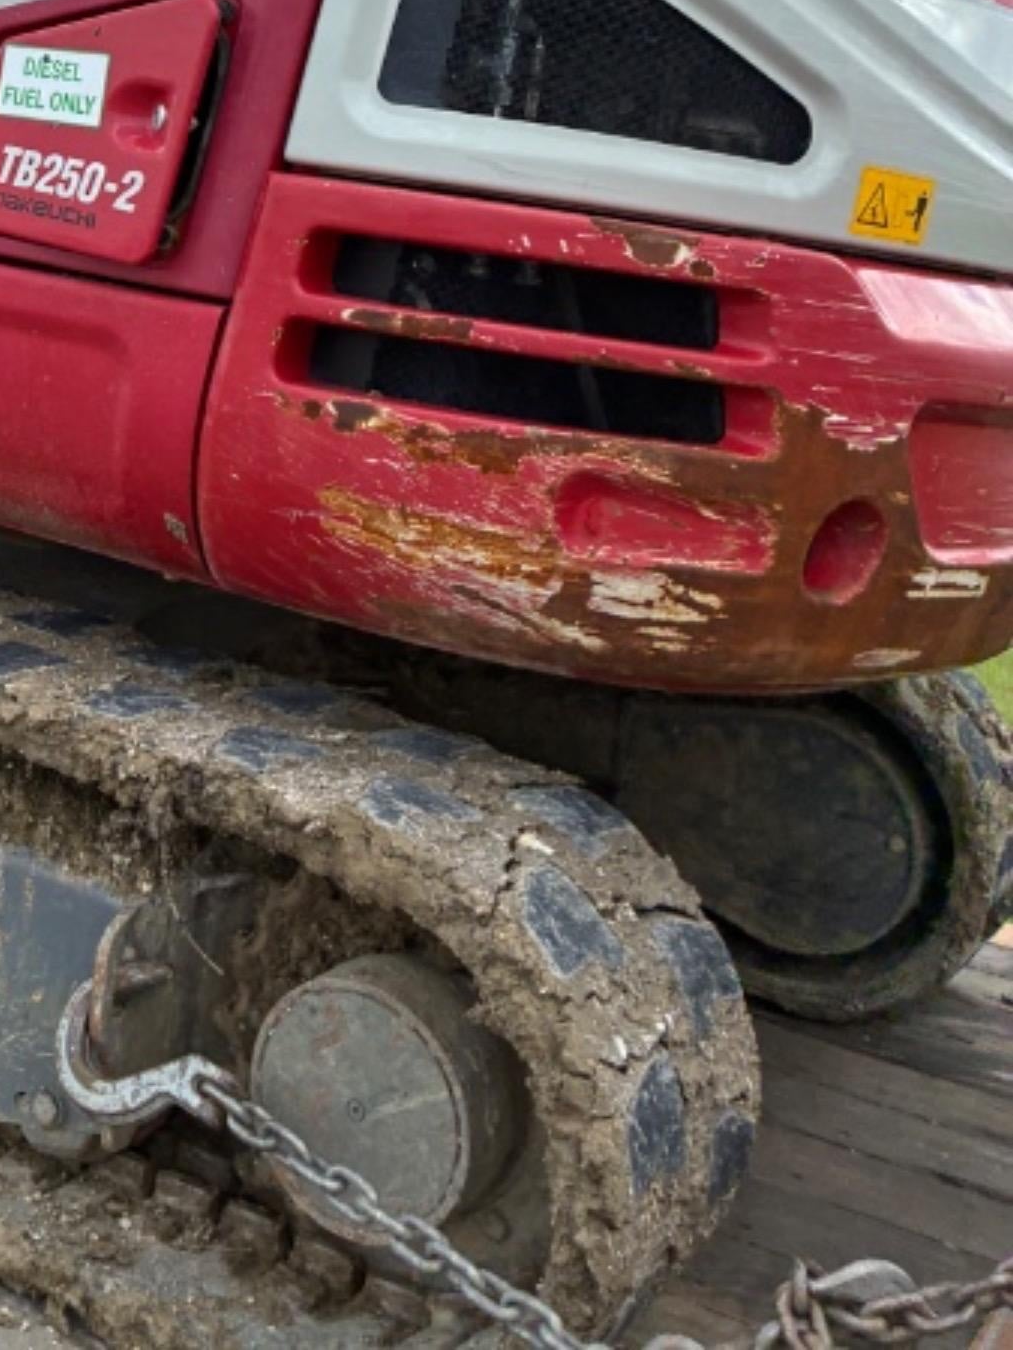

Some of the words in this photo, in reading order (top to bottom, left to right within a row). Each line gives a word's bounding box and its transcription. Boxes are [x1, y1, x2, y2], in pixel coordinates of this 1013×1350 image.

[23, 56, 82, 82] DIESEL
[2, 86, 45, 110] FUEL
[49, 91, 97, 116] ONLY
